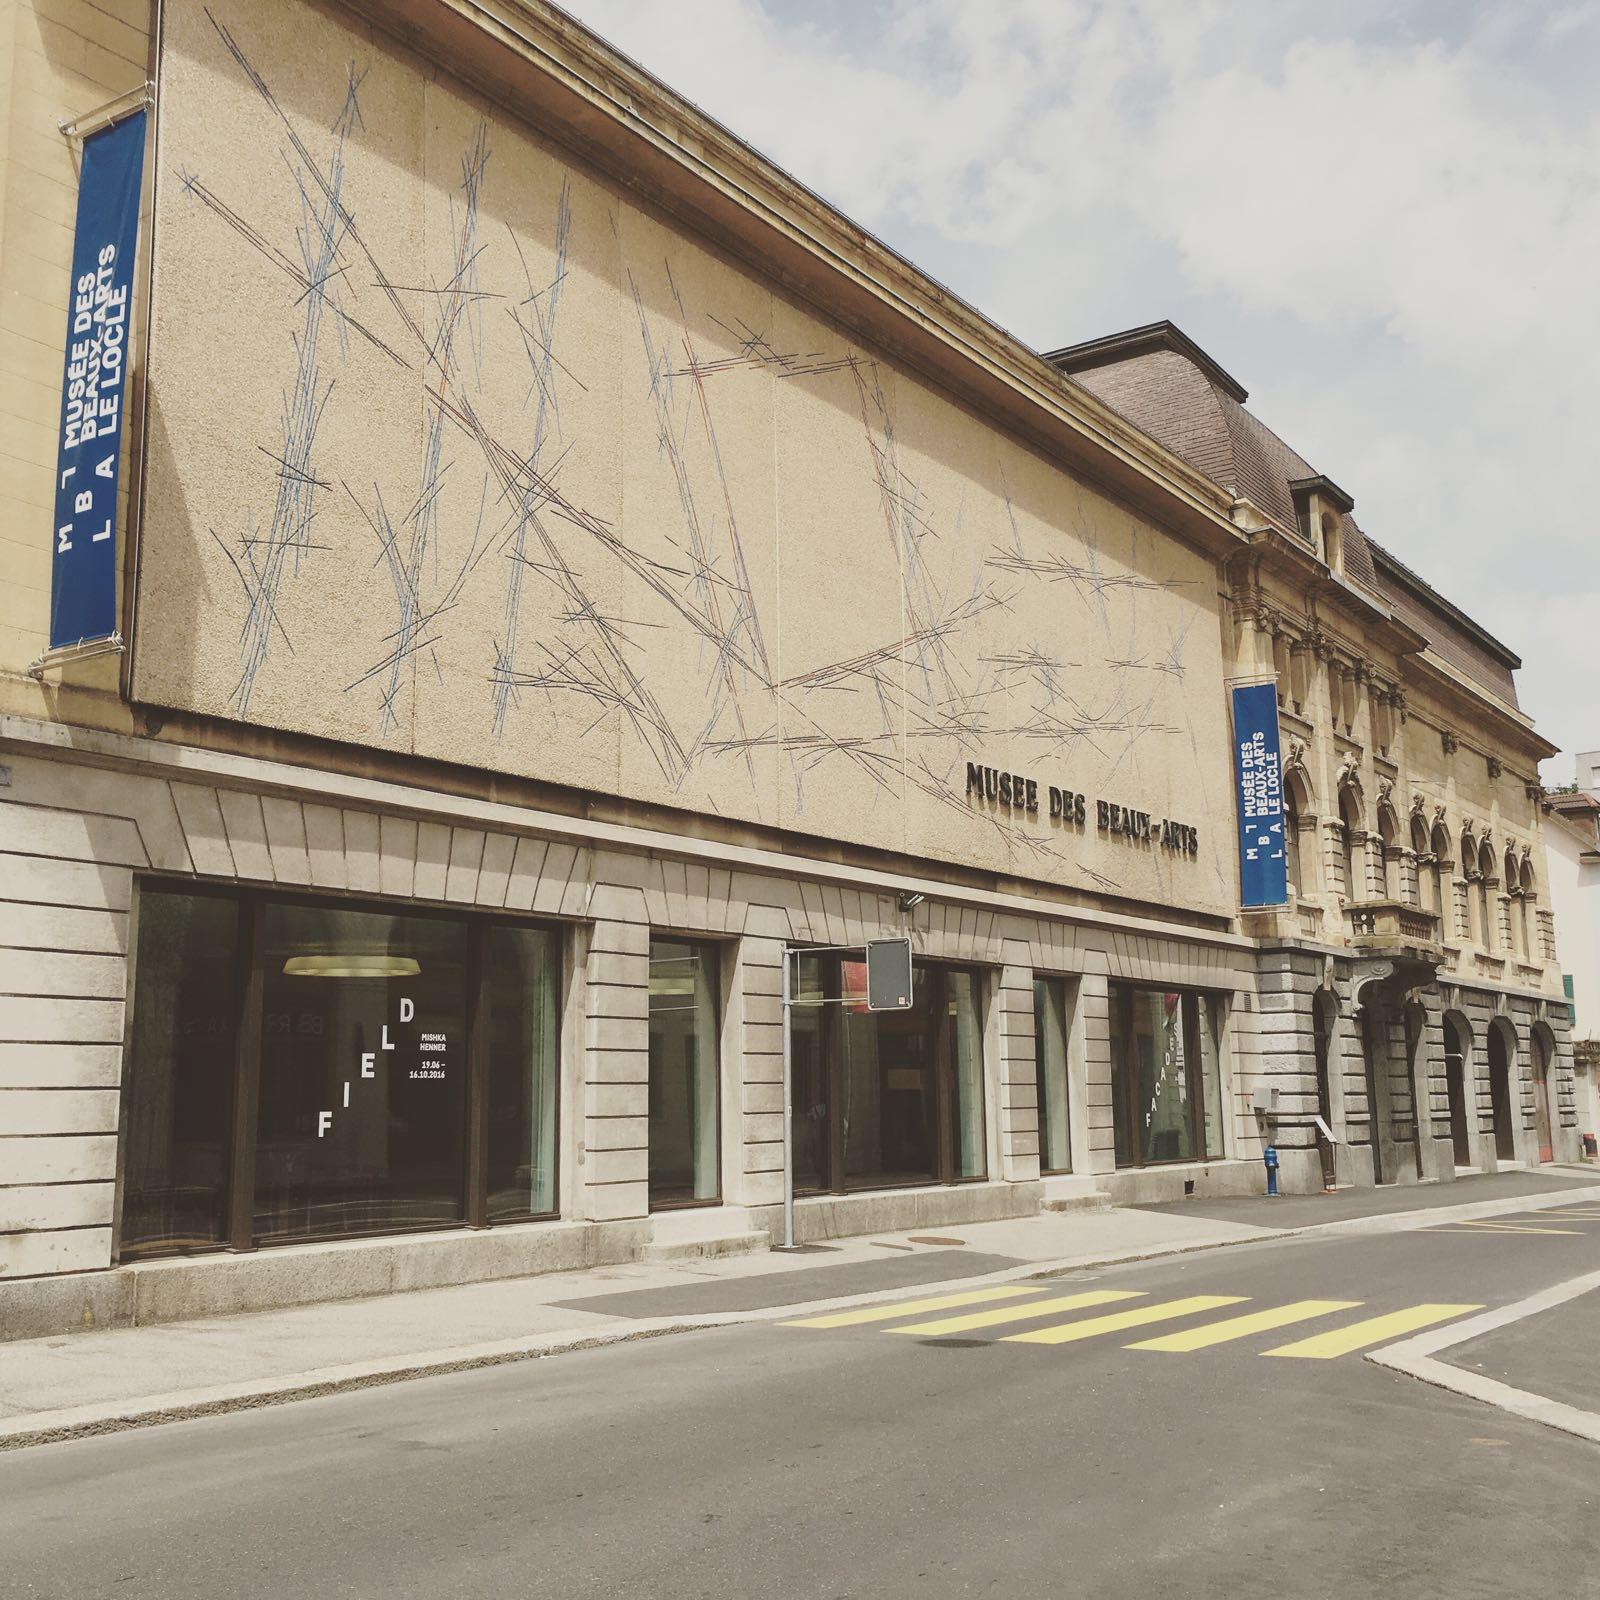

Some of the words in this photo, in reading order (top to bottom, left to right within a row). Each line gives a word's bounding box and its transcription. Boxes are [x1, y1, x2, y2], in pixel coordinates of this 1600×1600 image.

[73, 272, 96, 334] DES
[80, 243, 116, 443] BEAUX-ARTS
[101, 284, 127, 388] LOCLE
[64, 338, 89, 450] MUSÉE
[98, 394, 118, 437] LE
[1241, 742, 1254, 768] DES
[1253, 731, 1269, 816] BEAUX-ARTS
[1266, 752, 1280, 795] LOCLE
[966, 762, 1039, 814] MUSEE
[1049, 786, 1086, 825] DES
[1096, 799, 1198, 856] BEAUX-ARTS
[1242, 771, 1256, 817] MUSÉE
[1269, 798, 1280, 815] LE
[420, 1043, 446, 1051] HENNER
[421, 1033, 446, 1041] MISHKA
